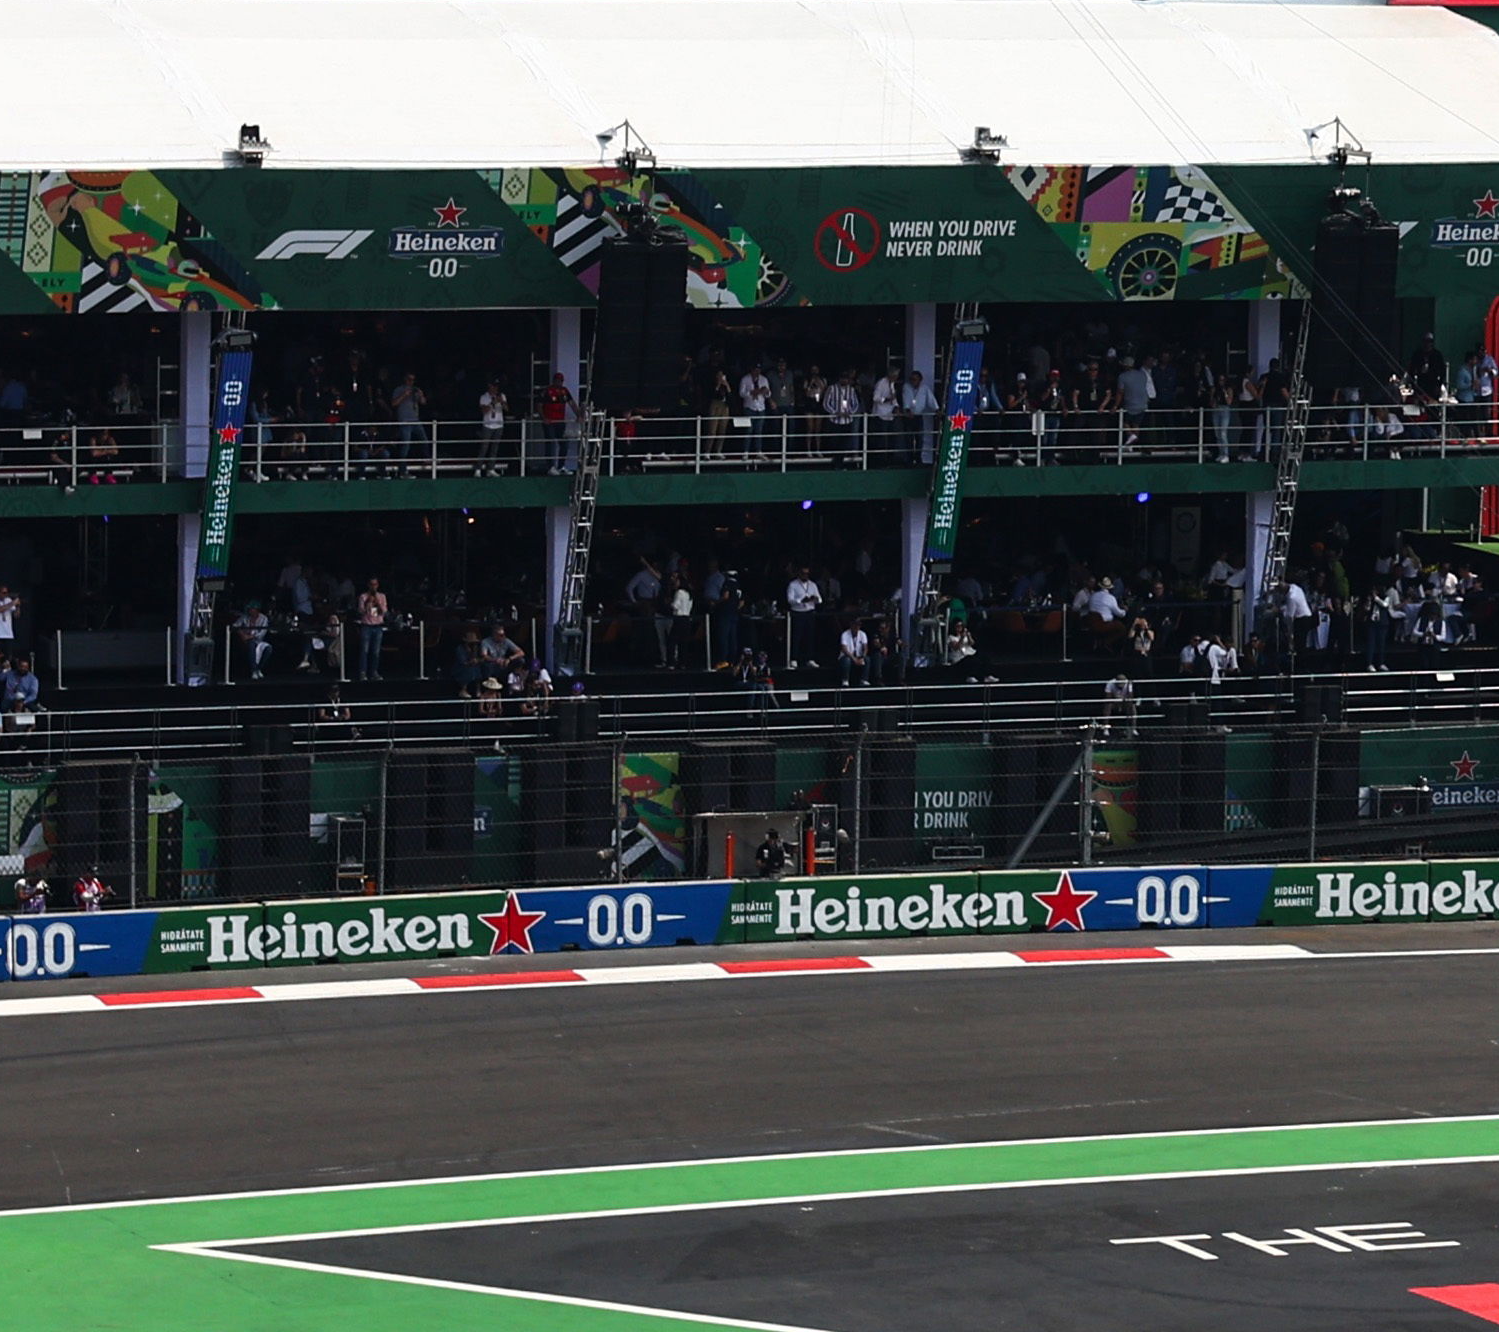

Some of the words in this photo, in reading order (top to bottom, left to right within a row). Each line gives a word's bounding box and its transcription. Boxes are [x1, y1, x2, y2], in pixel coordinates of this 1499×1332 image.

[395, 233, 497, 250] Heineken
[890, 221, 933, 237] WHEN
[939, 221, 969, 236] YOU
[973, 220, 1016, 236] DRIVE
[430, 258, 457, 277] 0.0
[886, 241, 932, 257] NEVER
[937, 240, 982, 256] DRINK
[1467, 248, 1492, 266] 0.0
[206, 447, 234, 545] Heineken
[934, 434, 964, 529] Heineken
[923, 791, 953, 808] YOU
[924, 812, 968, 828] DRINK
[589, 893, 651, 944] 0.0
[775, 884, 1027, 934] Heineken
[1138, 875, 1199, 925] 0.0
[7, 923, 75, 976] 0.0
[207, 908, 477, 966] Heineken
[1110, 1221, 1460, 1260] THE
